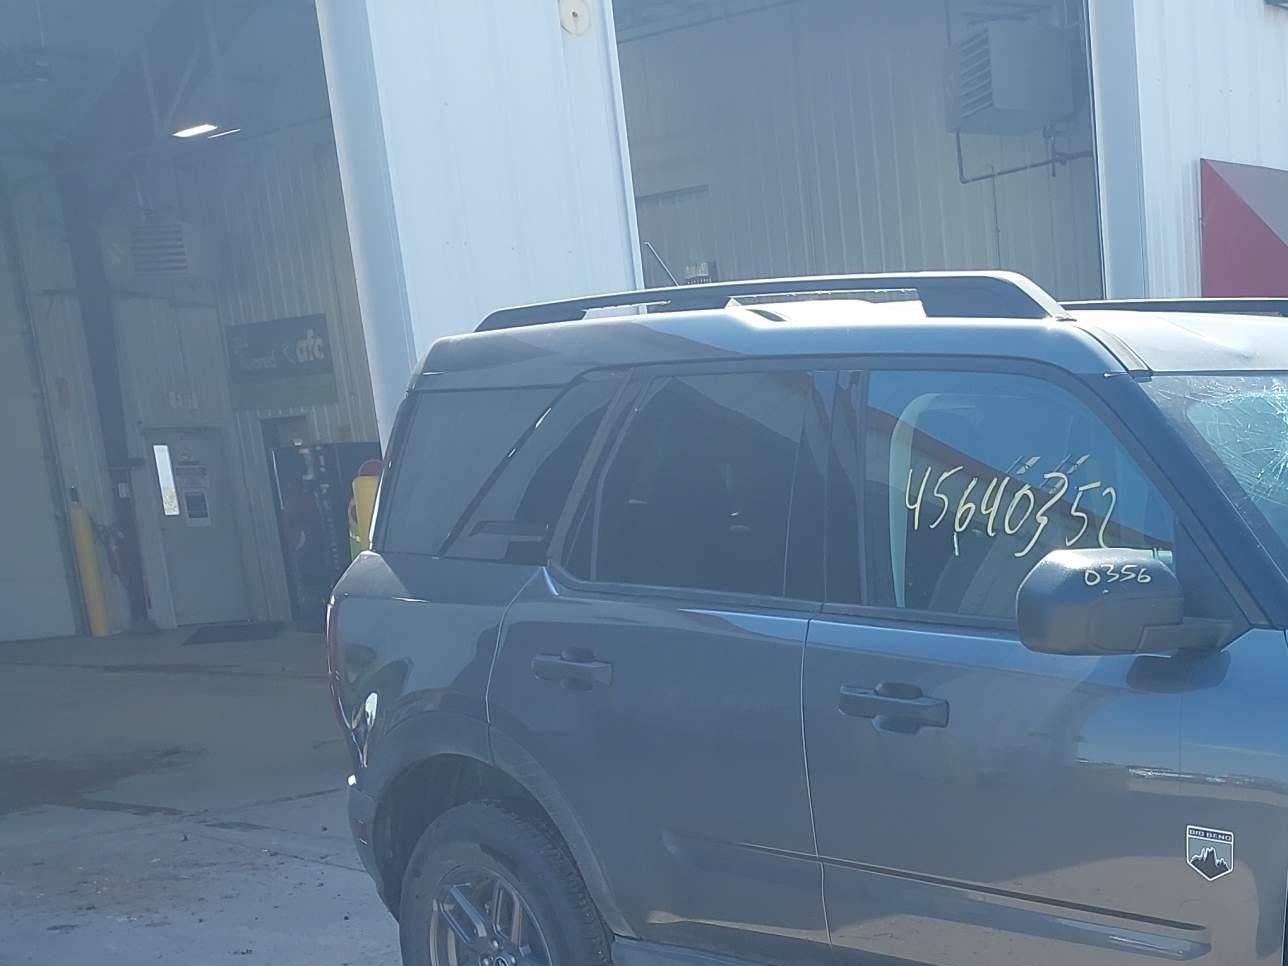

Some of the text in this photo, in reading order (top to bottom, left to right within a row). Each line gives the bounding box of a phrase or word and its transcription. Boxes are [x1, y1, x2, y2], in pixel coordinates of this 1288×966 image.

[1084, 564, 1152, 586] 0356
[1189, 829, 1231, 841] BIG BEND
